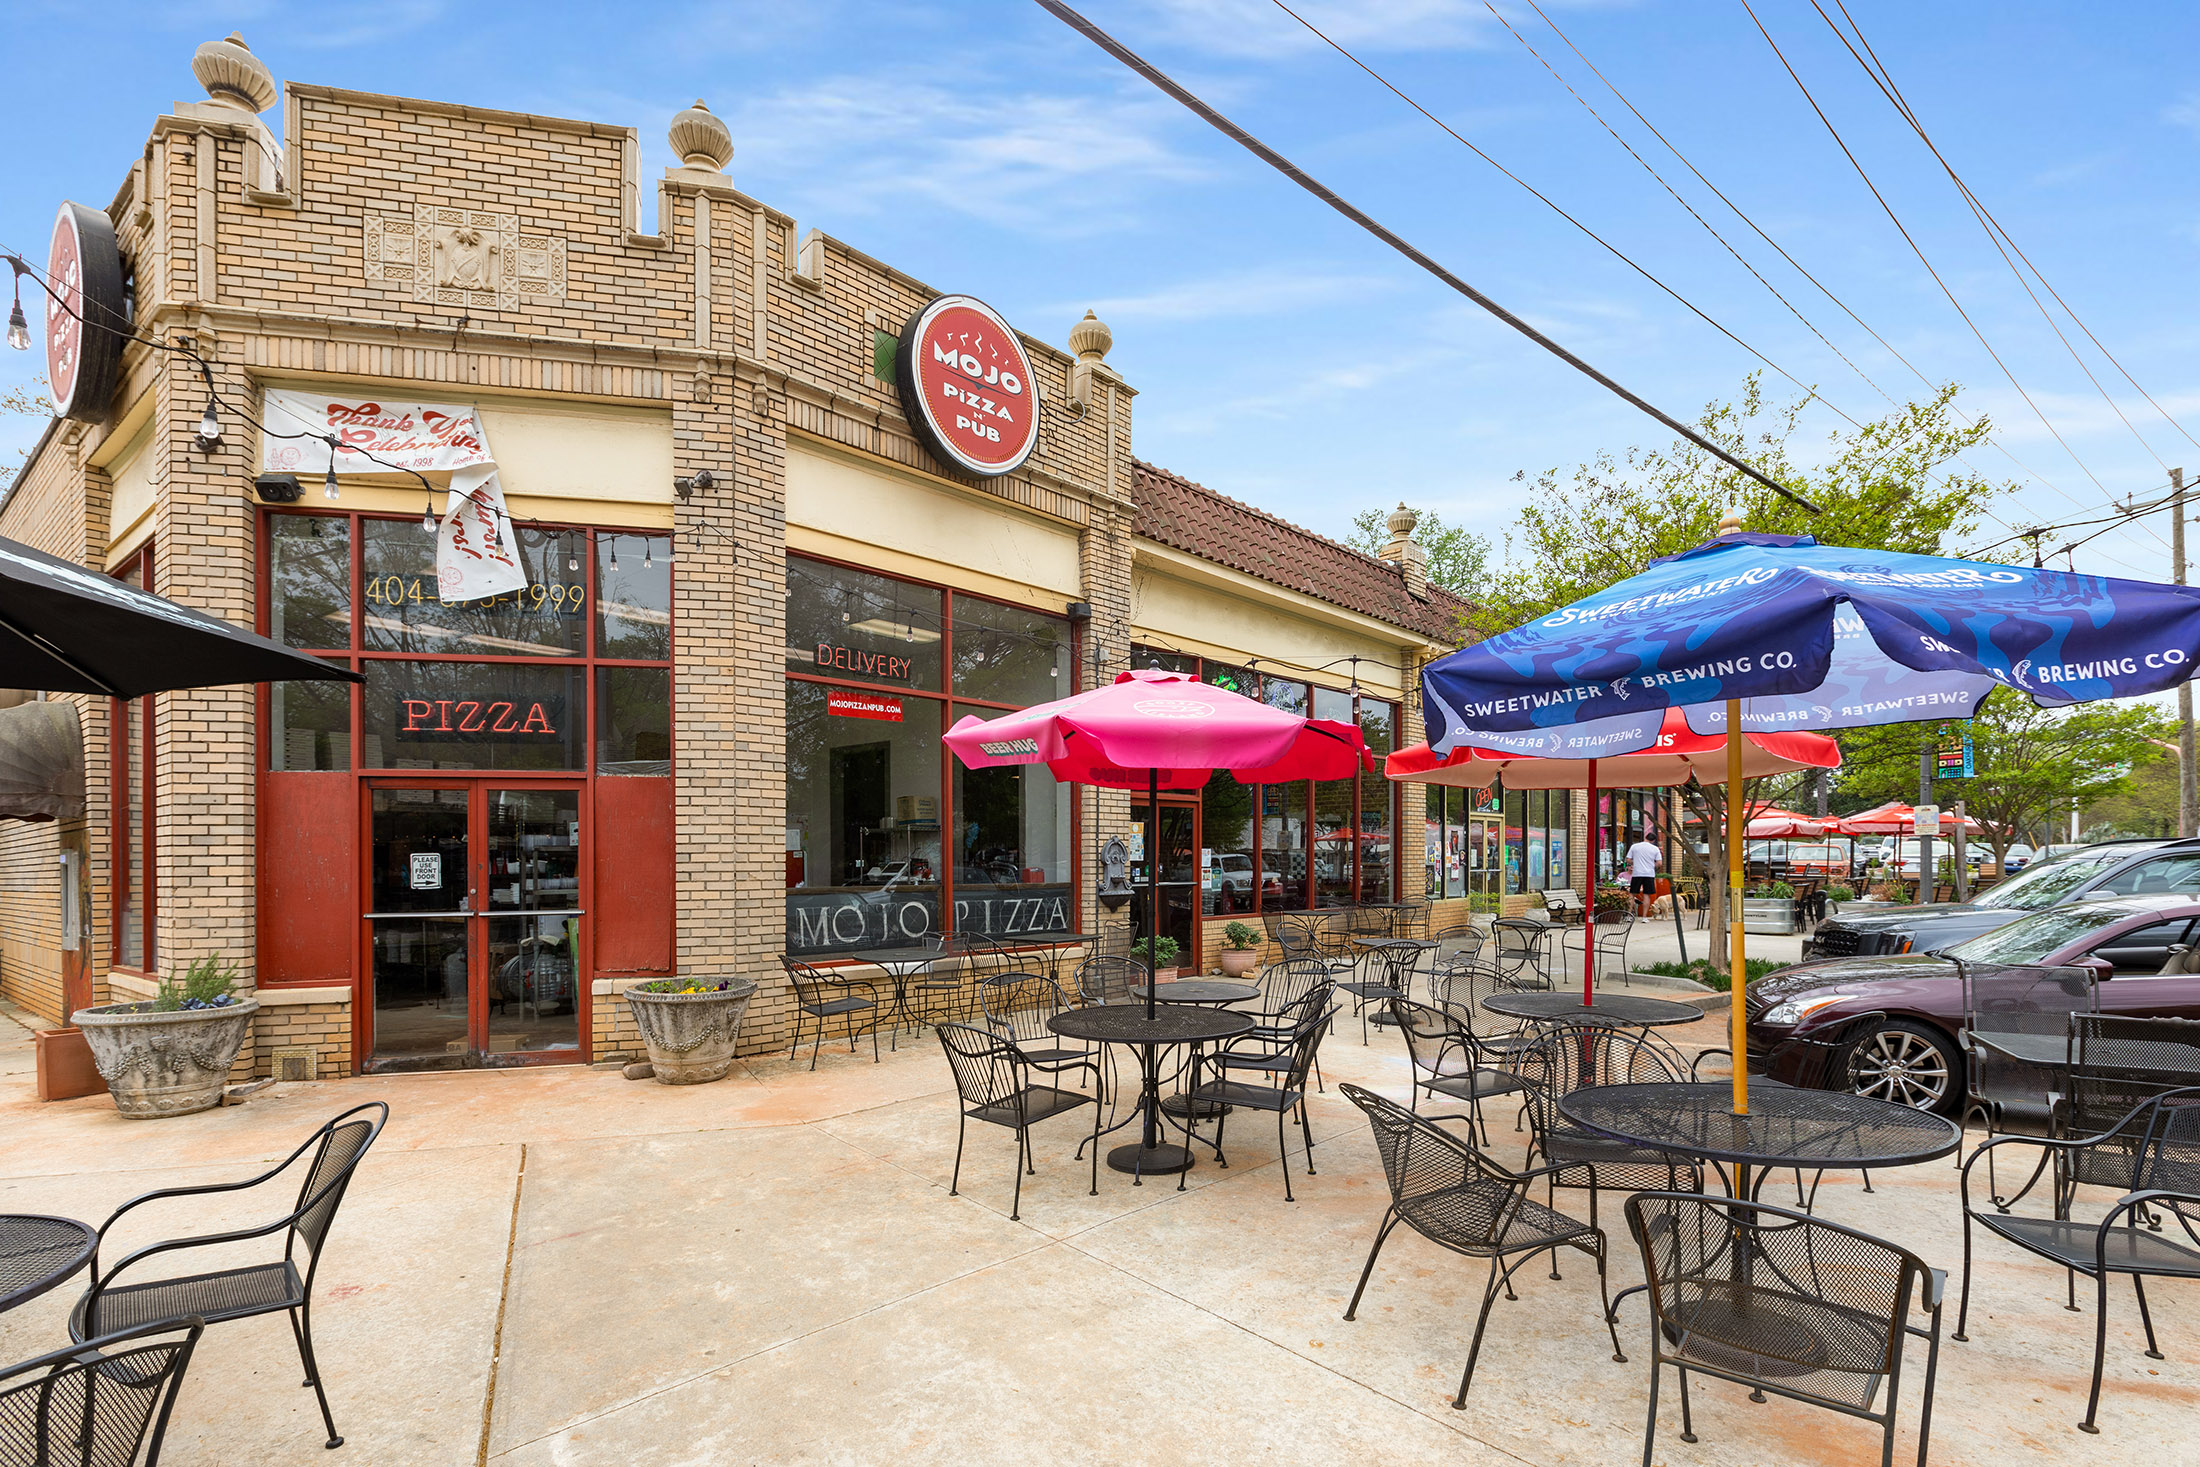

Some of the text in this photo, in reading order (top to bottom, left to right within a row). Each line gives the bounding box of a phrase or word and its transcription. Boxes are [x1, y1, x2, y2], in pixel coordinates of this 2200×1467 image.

[934, 340, 1022, 395] MOJO
[327, 403, 415, 431] Thank
[956, 415, 1001, 443] PUB
[413, 457, 434, 467] 1998
[366, 576, 585, 612] 404--1999
[1542, 567, 1780, 627] SWEETWATER
[818, 643, 911, 679] DELIVERY
[2038, 657, 2137, 684] BREWING
[2145, 649, 2190, 669] CO.
[1464, 652, 1798, 718] SWEETWATER BREWING CO.
[402, 700, 555, 734] PIZZA
[830, 700, 901, 713] MOJOPIZZANPUB.COM
[979, 738, 1039, 757] BEER HUG
[1475, 787, 1493, 807] OPEN
[797, 897, 1068, 948] MOJO PIZZA
